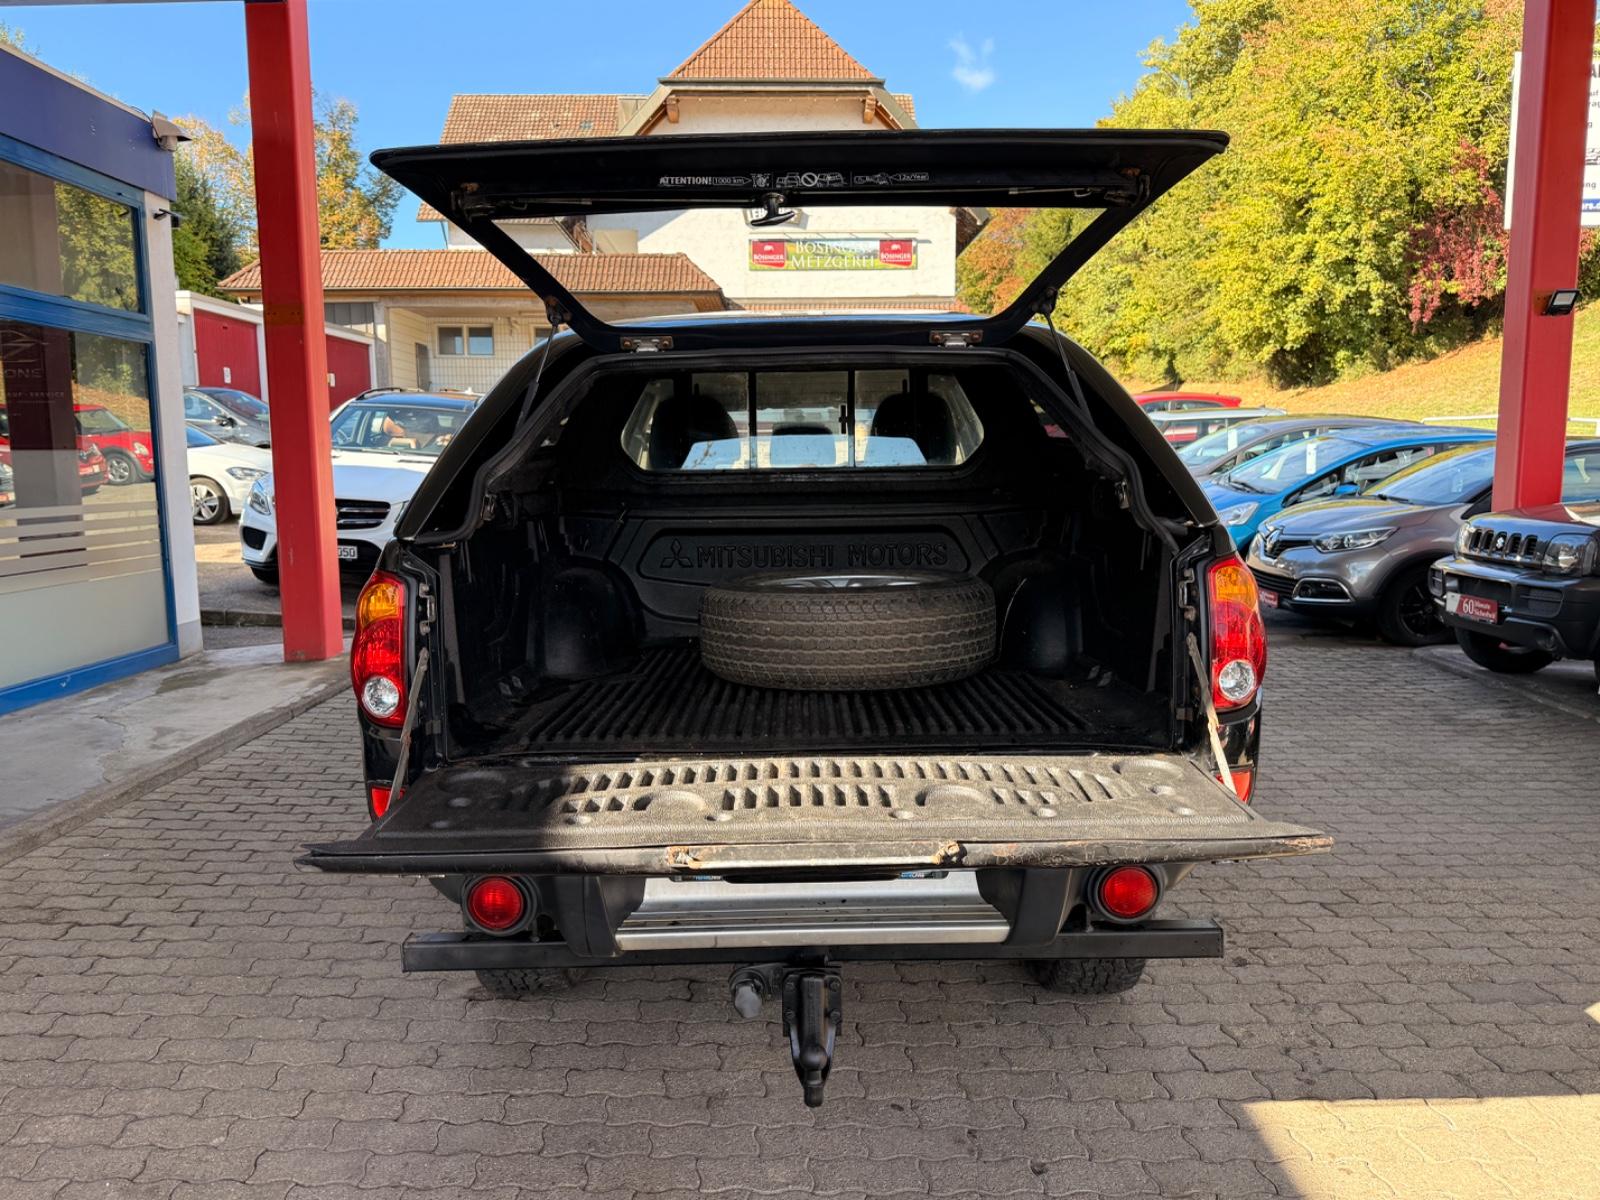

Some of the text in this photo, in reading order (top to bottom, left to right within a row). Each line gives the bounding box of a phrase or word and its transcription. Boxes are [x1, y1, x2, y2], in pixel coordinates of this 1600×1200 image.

[659, 176, 712, 186] ATTENTION!
[714, 177, 731, 185] 1000
[791, 254, 875, 269] METZGEREI
[696, 542, 949, 569] MITSUBISHI MOTORS
[1462, 598, 1474, 615] 60
